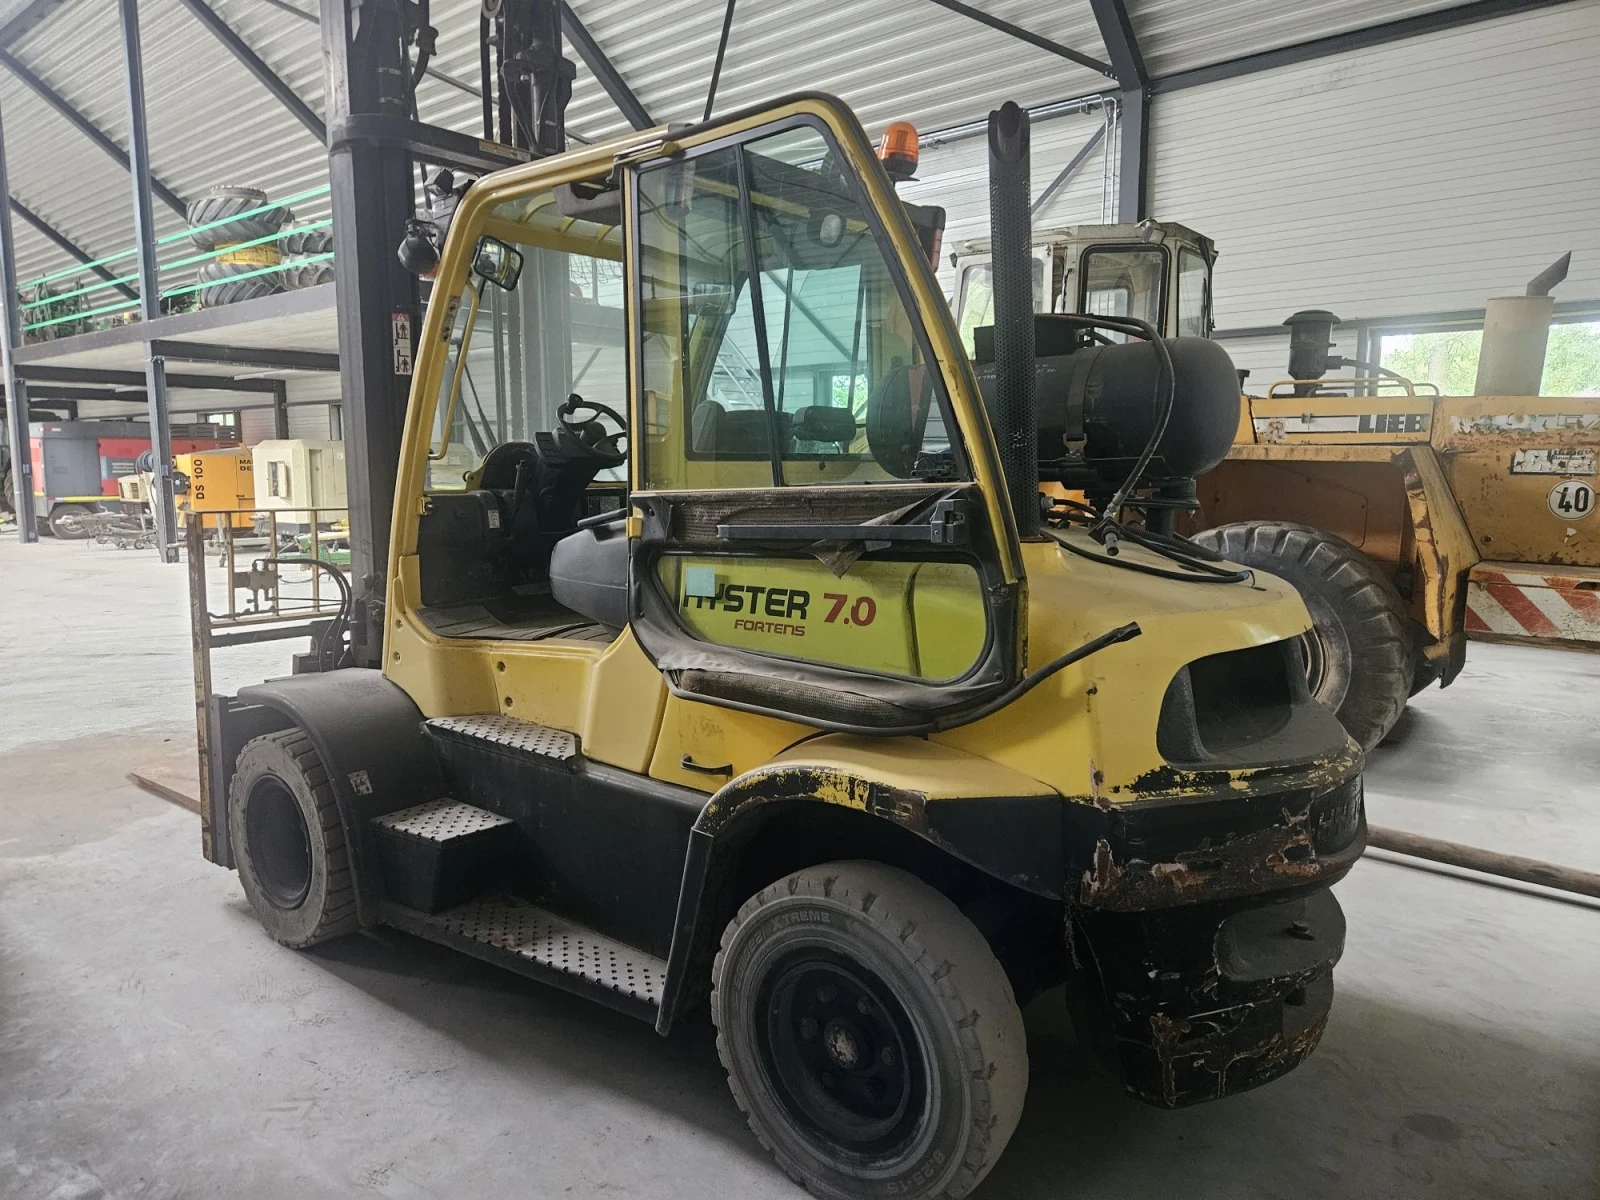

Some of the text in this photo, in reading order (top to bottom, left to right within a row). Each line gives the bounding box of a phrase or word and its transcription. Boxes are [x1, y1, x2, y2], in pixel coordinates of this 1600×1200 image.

[1358, 414, 1424, 433] LIEB
[194, 459, 205, 499] DS 100
[1557, 486, 1590, 513] 40
[823, 592, 877, 627] 7.0
[770, 910, 831, 932] XTREME
